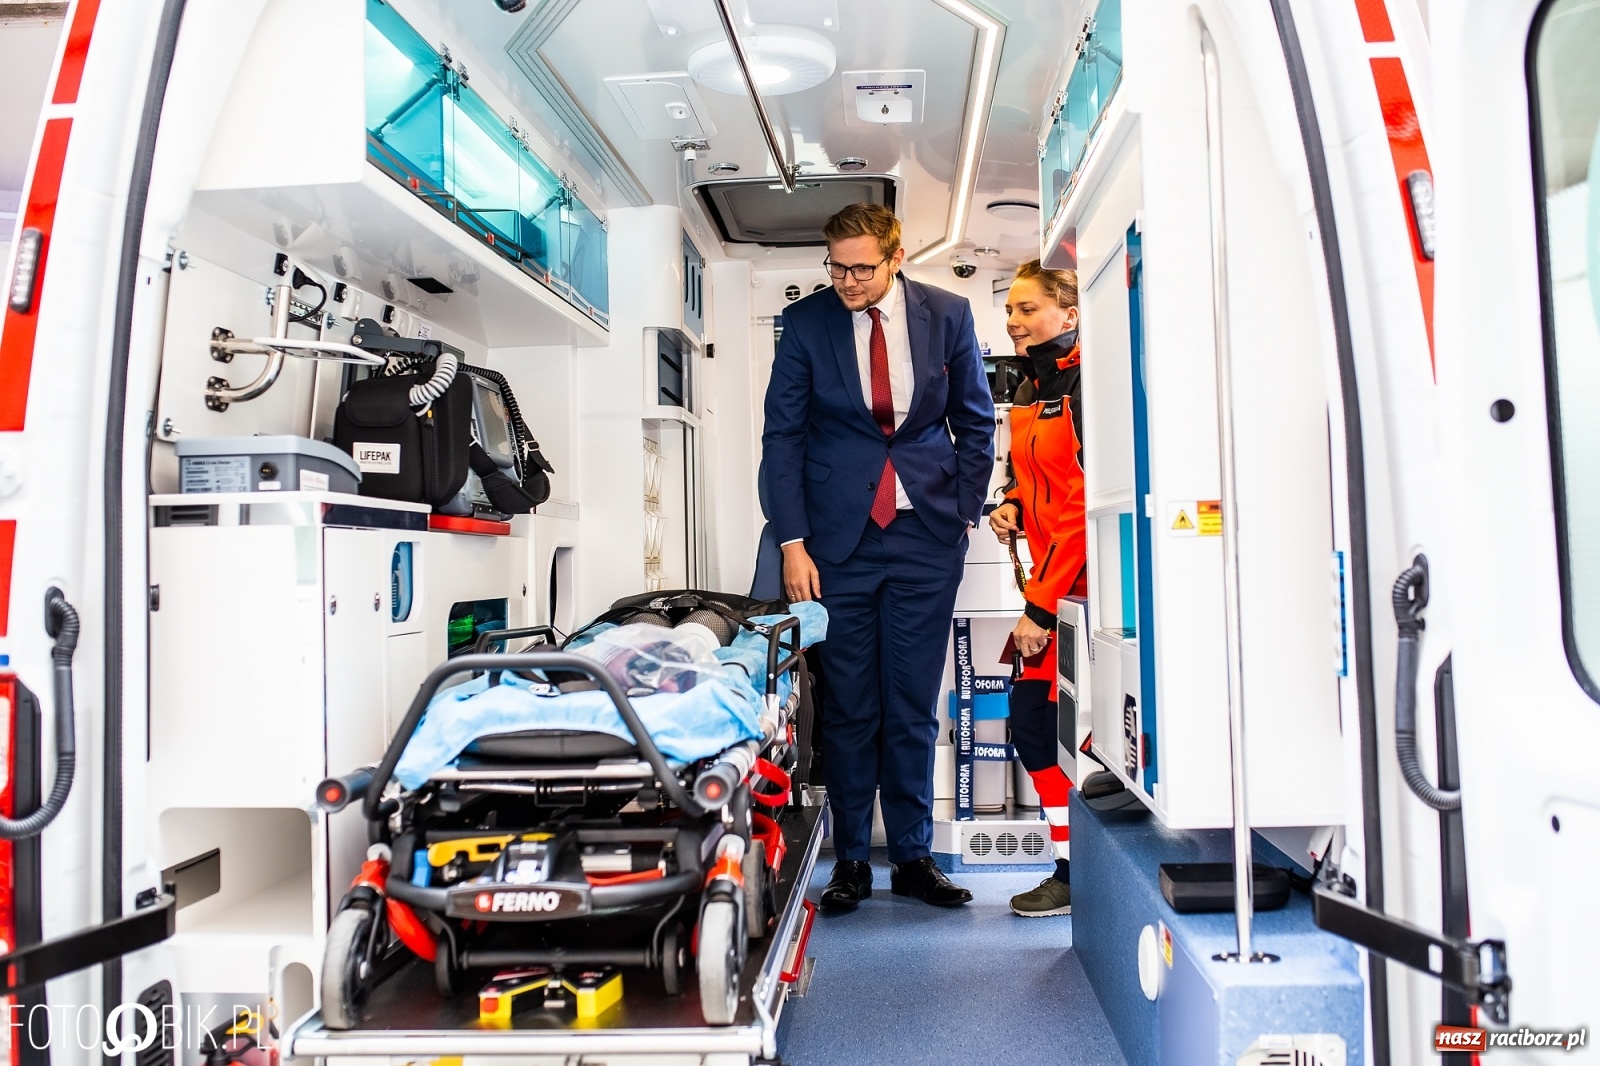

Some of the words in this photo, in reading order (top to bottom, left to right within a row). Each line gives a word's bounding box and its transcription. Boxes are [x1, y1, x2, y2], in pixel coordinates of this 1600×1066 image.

[360, 450, 391, 461] LIFEPAK
[974, 679, 1005, 690] OFORM
[960, 708, 971, 751] AUTOFORM
[959, 764, 970, 808] AUTOFORM
[491, 891, 561, 912] FERNO
